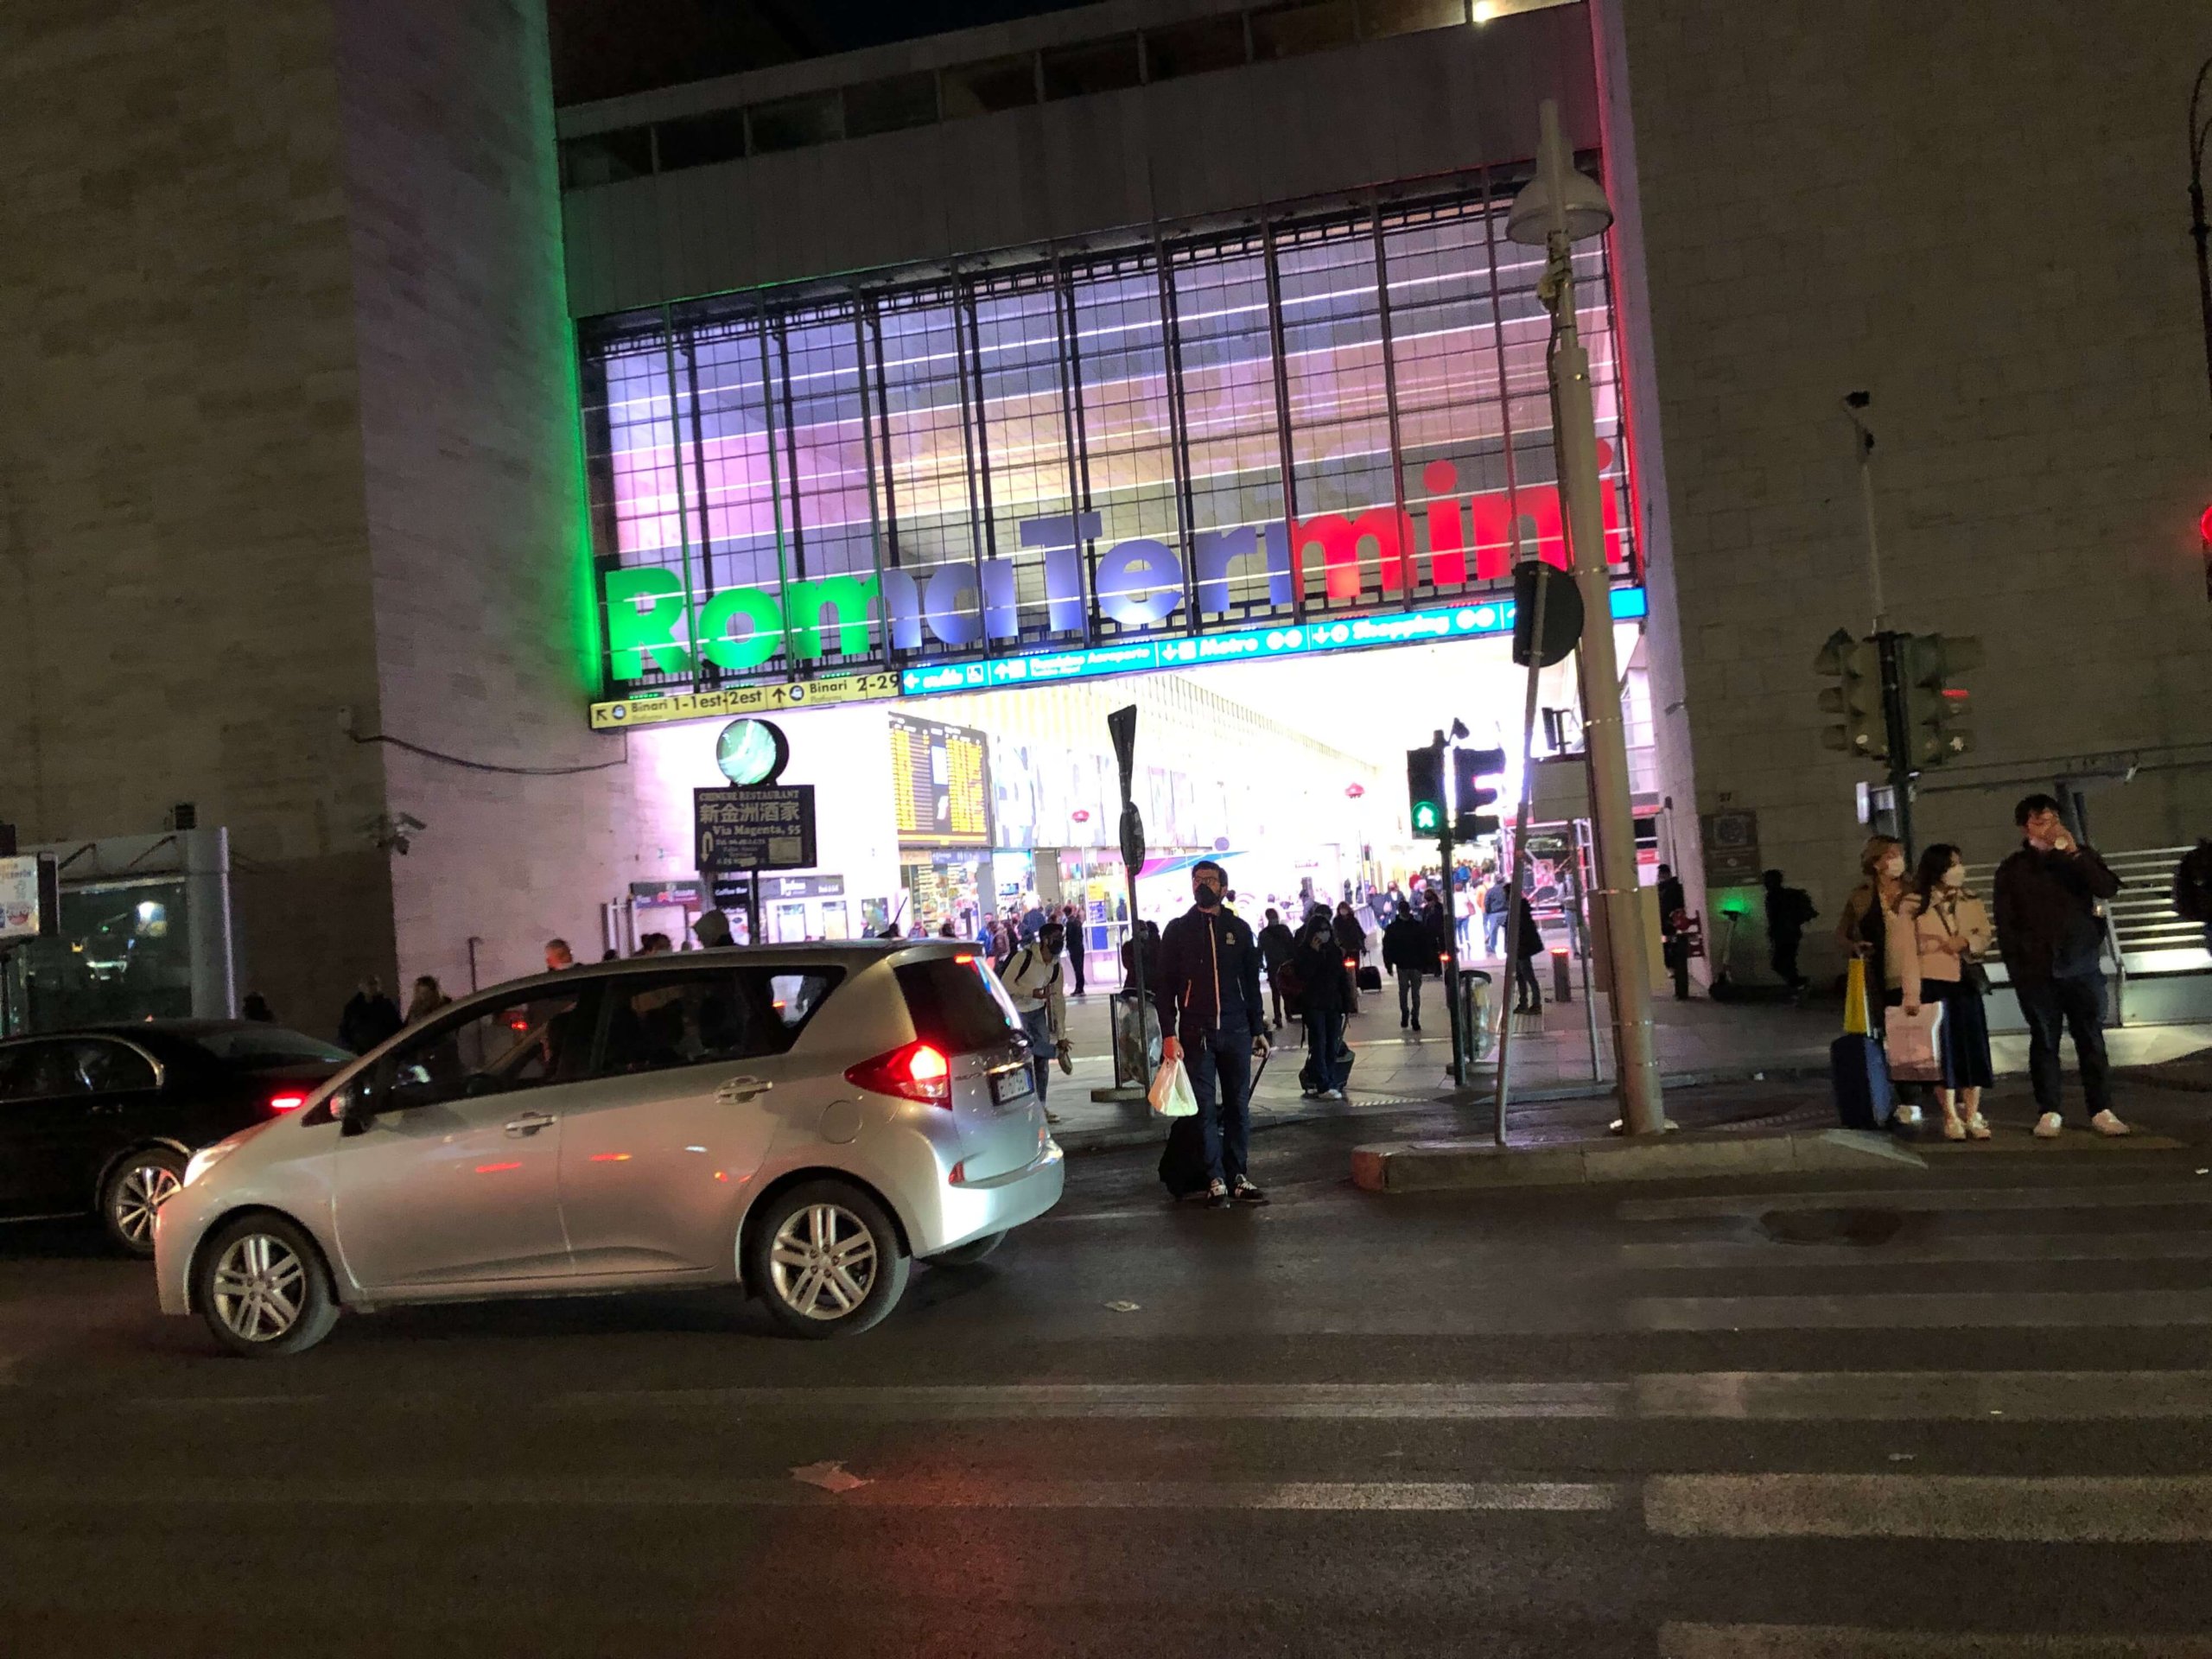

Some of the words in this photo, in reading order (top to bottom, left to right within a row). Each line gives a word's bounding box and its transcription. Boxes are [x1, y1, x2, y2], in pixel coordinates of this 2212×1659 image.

[605, 558, 1019, 681] Roma
[810, 680, 848, 694] Binari
[856, 673, 899, 693] 2-29
[632, 699, 667, 713] Binari
[700, 801, 800, 823] 新金洲酒家
[713, 825, 733, 836] Via
